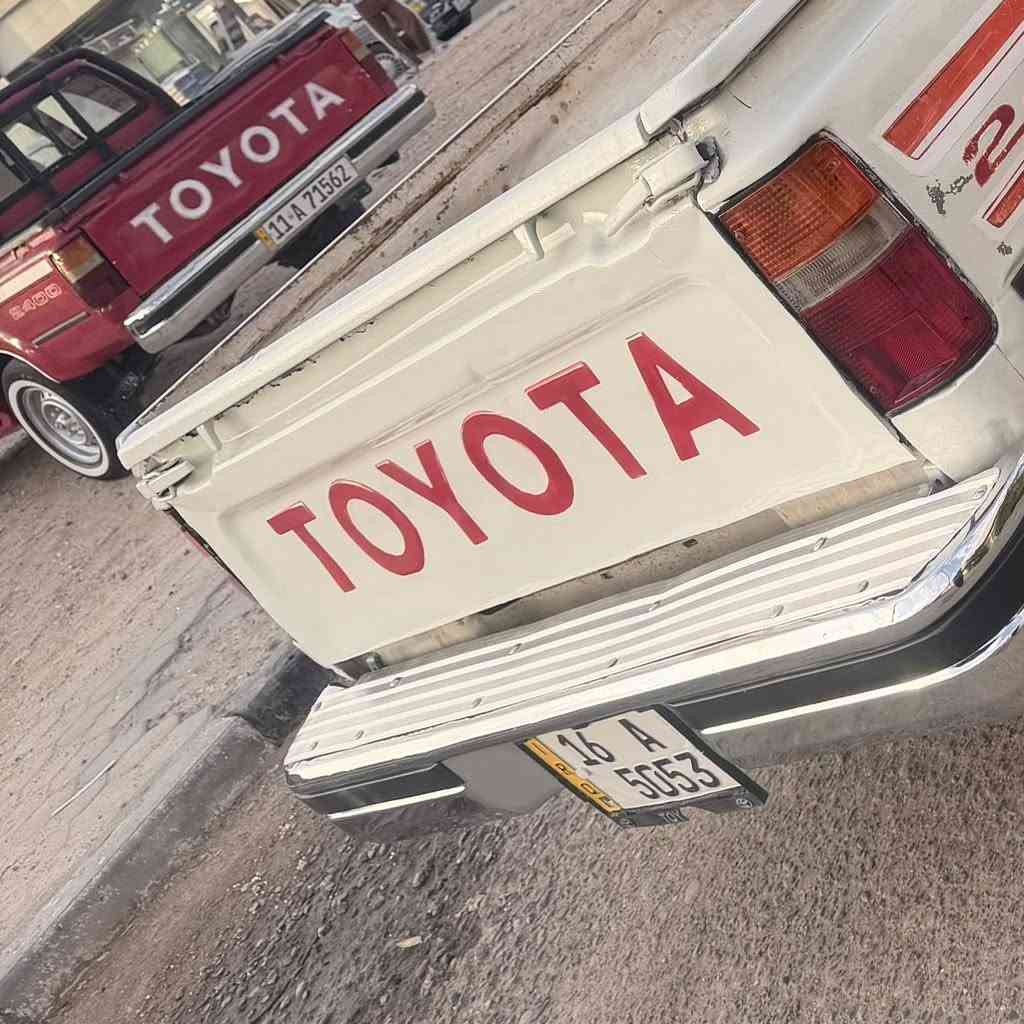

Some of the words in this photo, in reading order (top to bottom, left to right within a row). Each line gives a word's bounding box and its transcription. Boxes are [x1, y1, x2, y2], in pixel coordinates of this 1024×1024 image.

[131, 81, 346, 244] TOYOTA
[268, 215, 293, 239] 11
[291, 203, 308, 221] A
[302, 164, 352, 209] 71562
[9, 283, 62, 320] 2400
[267, 332, 760, 593] TOYOTA
[557, 732, 615, 766] 16
[618, 718, 668, 753] A
[614, 752, 721, 800] 5053
